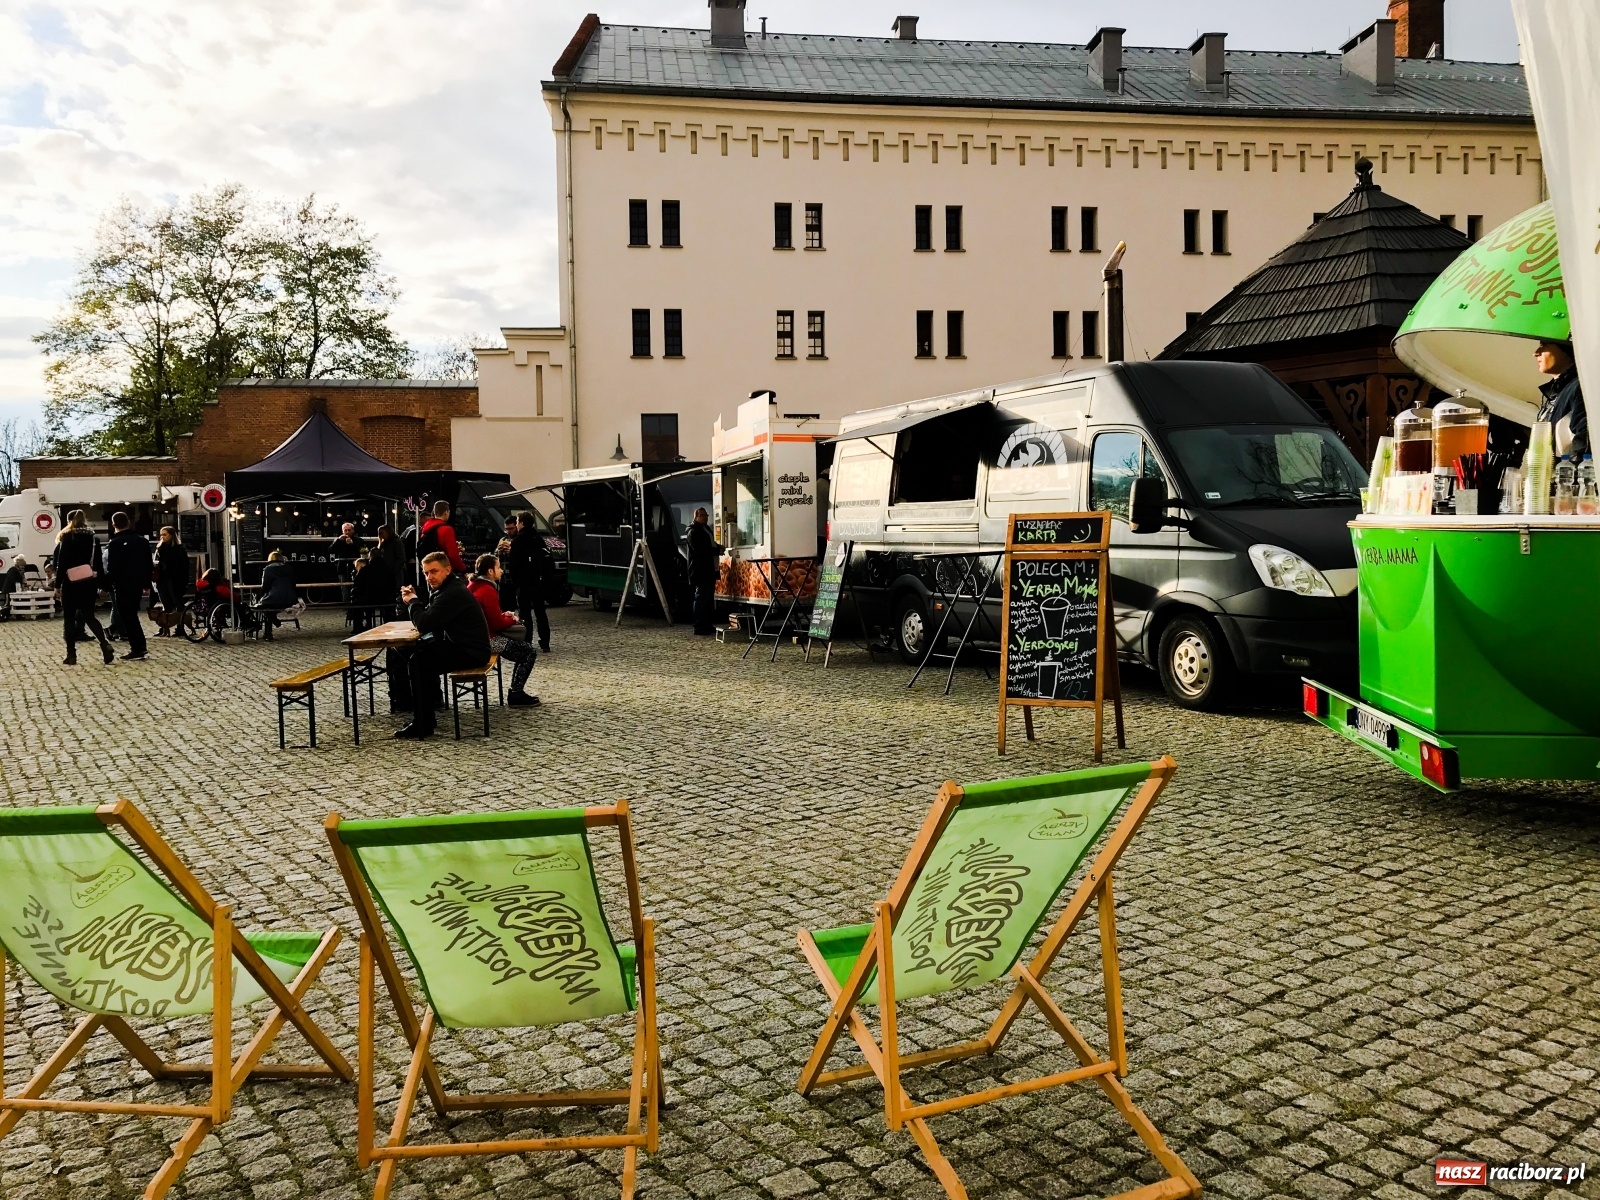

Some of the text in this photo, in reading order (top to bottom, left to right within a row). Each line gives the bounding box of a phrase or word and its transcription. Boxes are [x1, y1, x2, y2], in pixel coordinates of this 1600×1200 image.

[781, 486, 803, 496] mini
[778, 494, 814, 509] pączki
[1018, 529, 1057, 543] KARTĄ
